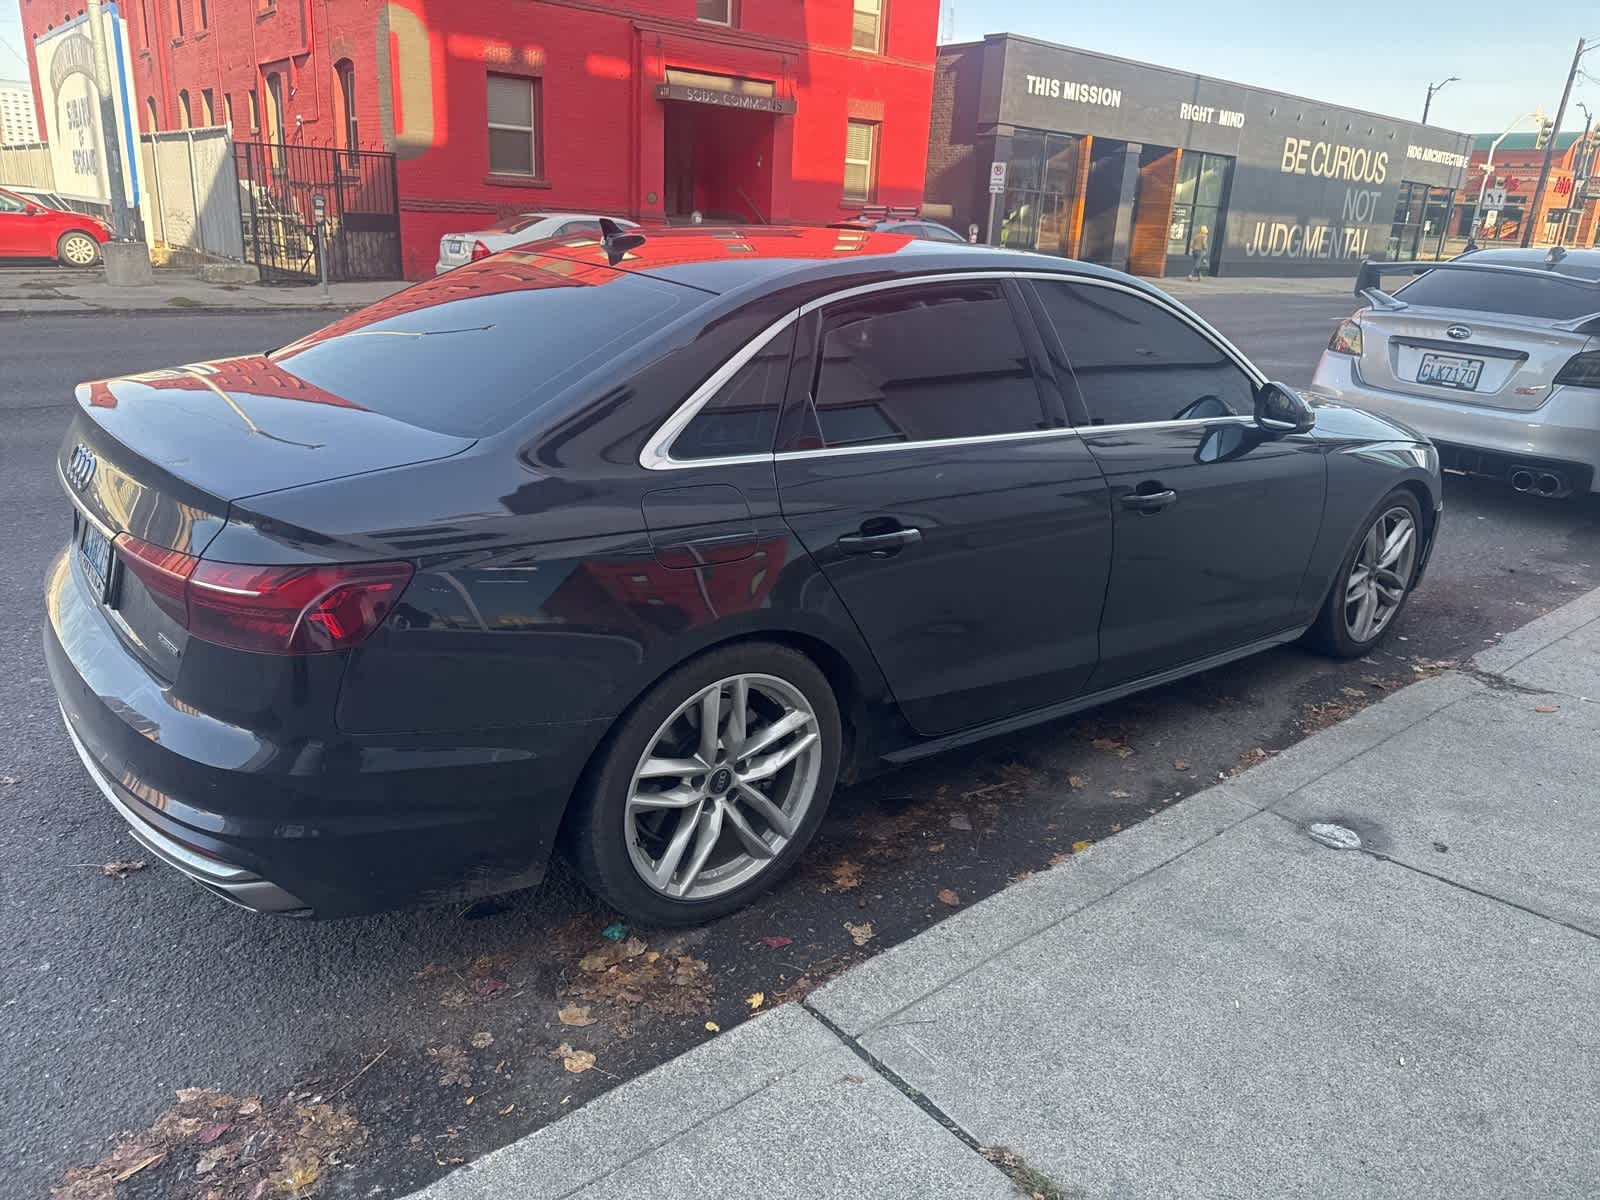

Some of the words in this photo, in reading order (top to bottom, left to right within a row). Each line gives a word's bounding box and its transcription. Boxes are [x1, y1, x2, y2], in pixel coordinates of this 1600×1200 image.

[1026, 74, 1060, 98] THIS
[1062, 82, 1122, 108] MISSION
[1180, 102, 1215, 123] RIGHT
[1218, 109, 1245, 129] MIND
[1280, 136, 1312, 175] BE
[1310, 140, 1389, 184] CURIOUS
[1406, 144, 1423, 160] HDG
[1342, 188, 1381, 223] NOT
[1245, 222, 1370, 260] JUDGMENTAL
[1421, 363, 1476, 385] CLK7170
